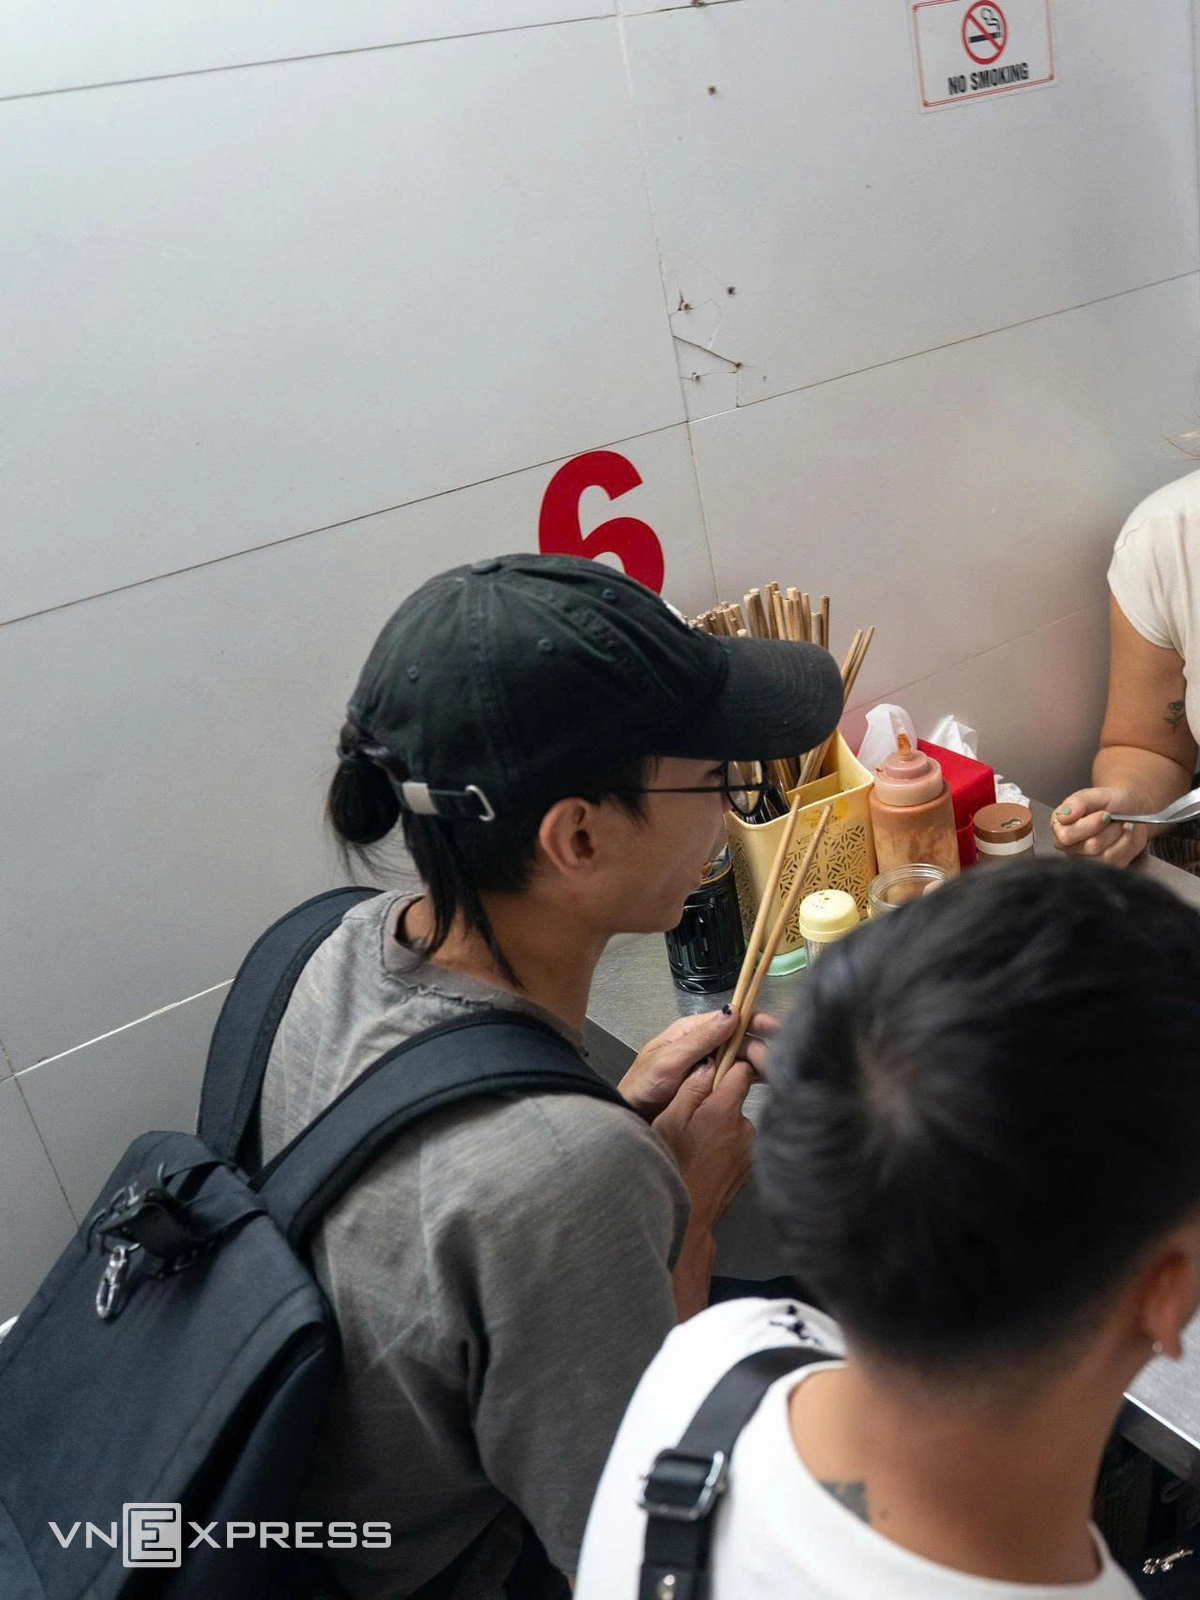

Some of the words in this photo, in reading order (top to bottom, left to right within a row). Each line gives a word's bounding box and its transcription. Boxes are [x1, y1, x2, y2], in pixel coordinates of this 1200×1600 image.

[948, 75, 966, 95] NO
[970, 63, 1029, 90] SMOKING
[538, 450, 664, 596] 6
